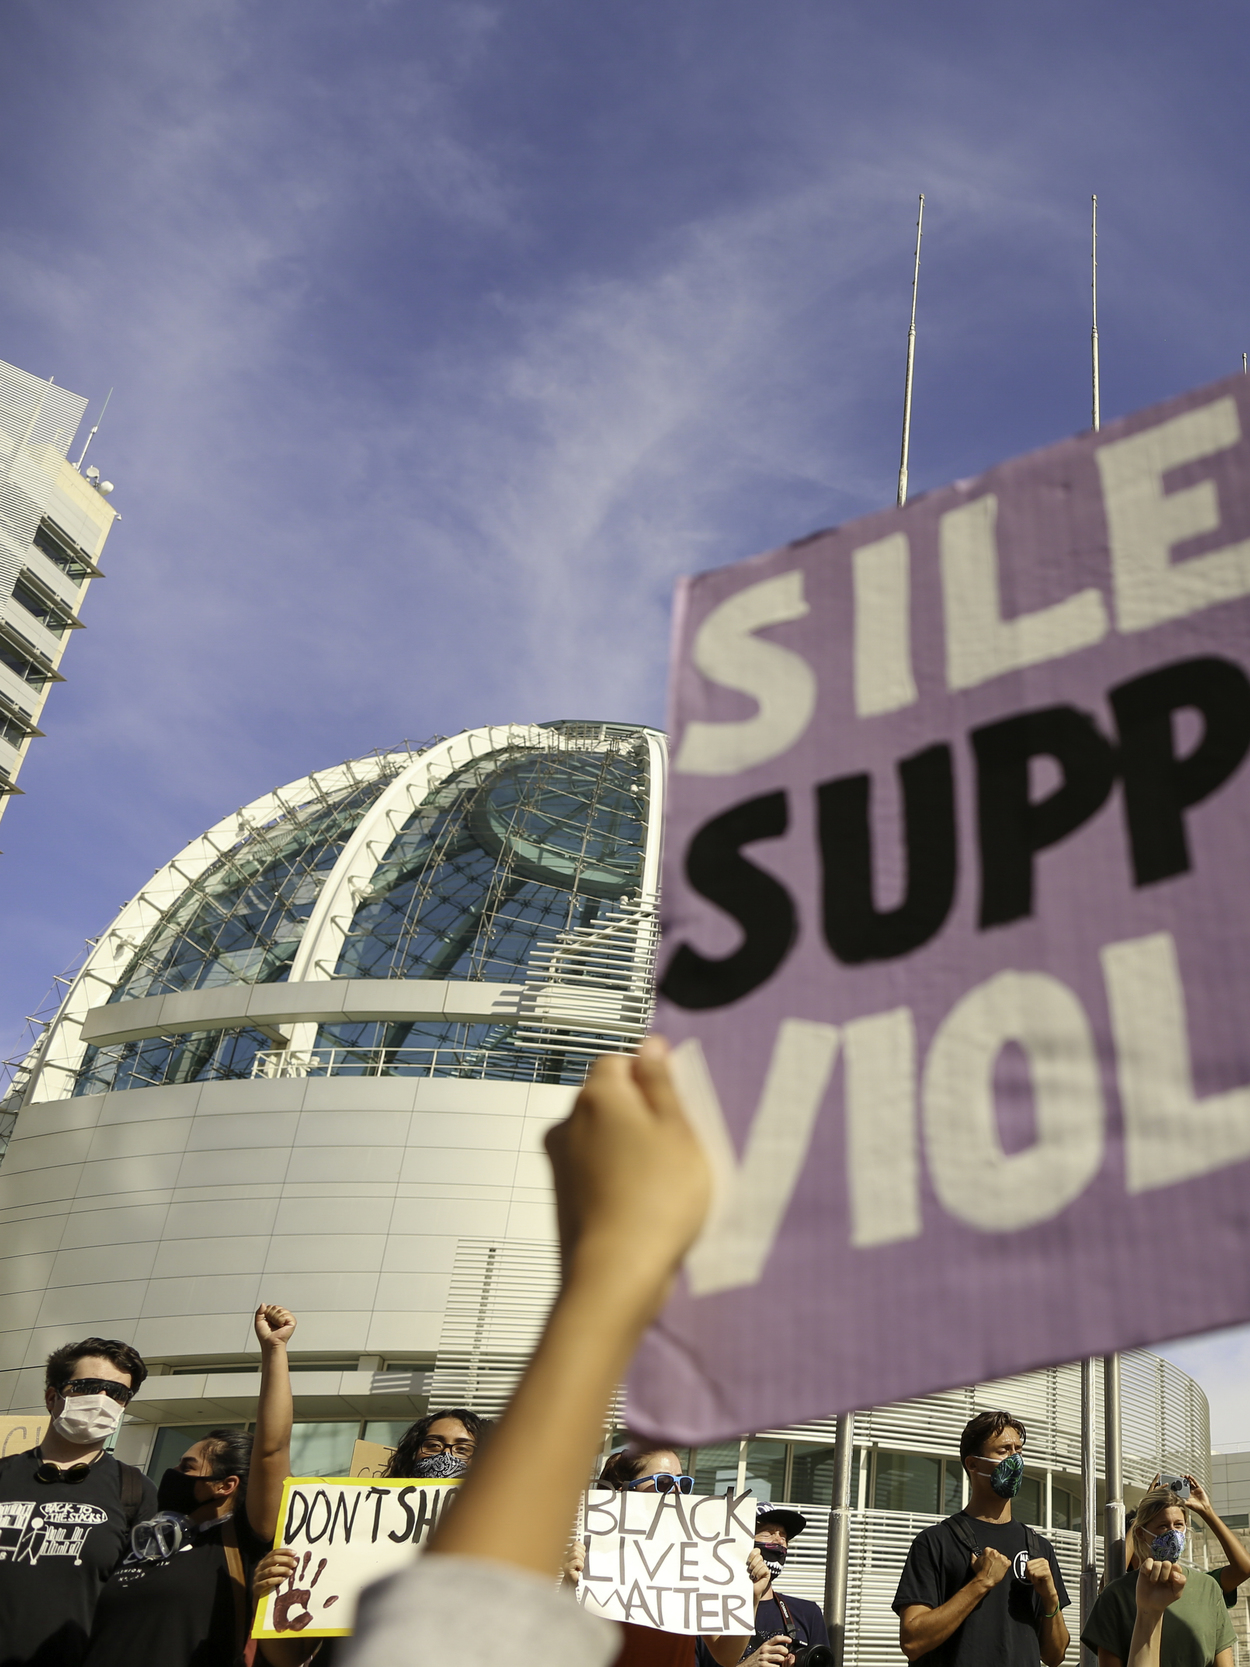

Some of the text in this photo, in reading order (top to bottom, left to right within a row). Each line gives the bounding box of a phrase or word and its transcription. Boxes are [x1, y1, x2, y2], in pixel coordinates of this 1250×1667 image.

[45, 1502, 93, 1513] BACK TO
[49, 1512, 68, 1522] THE
[284, 1487, 391, 1545] DON'T
[584, 1480, 756, 1542] BLACK
[583, 1535, 736, 1586] LIVES
[583, 1578, 755, 1632] MATTER
